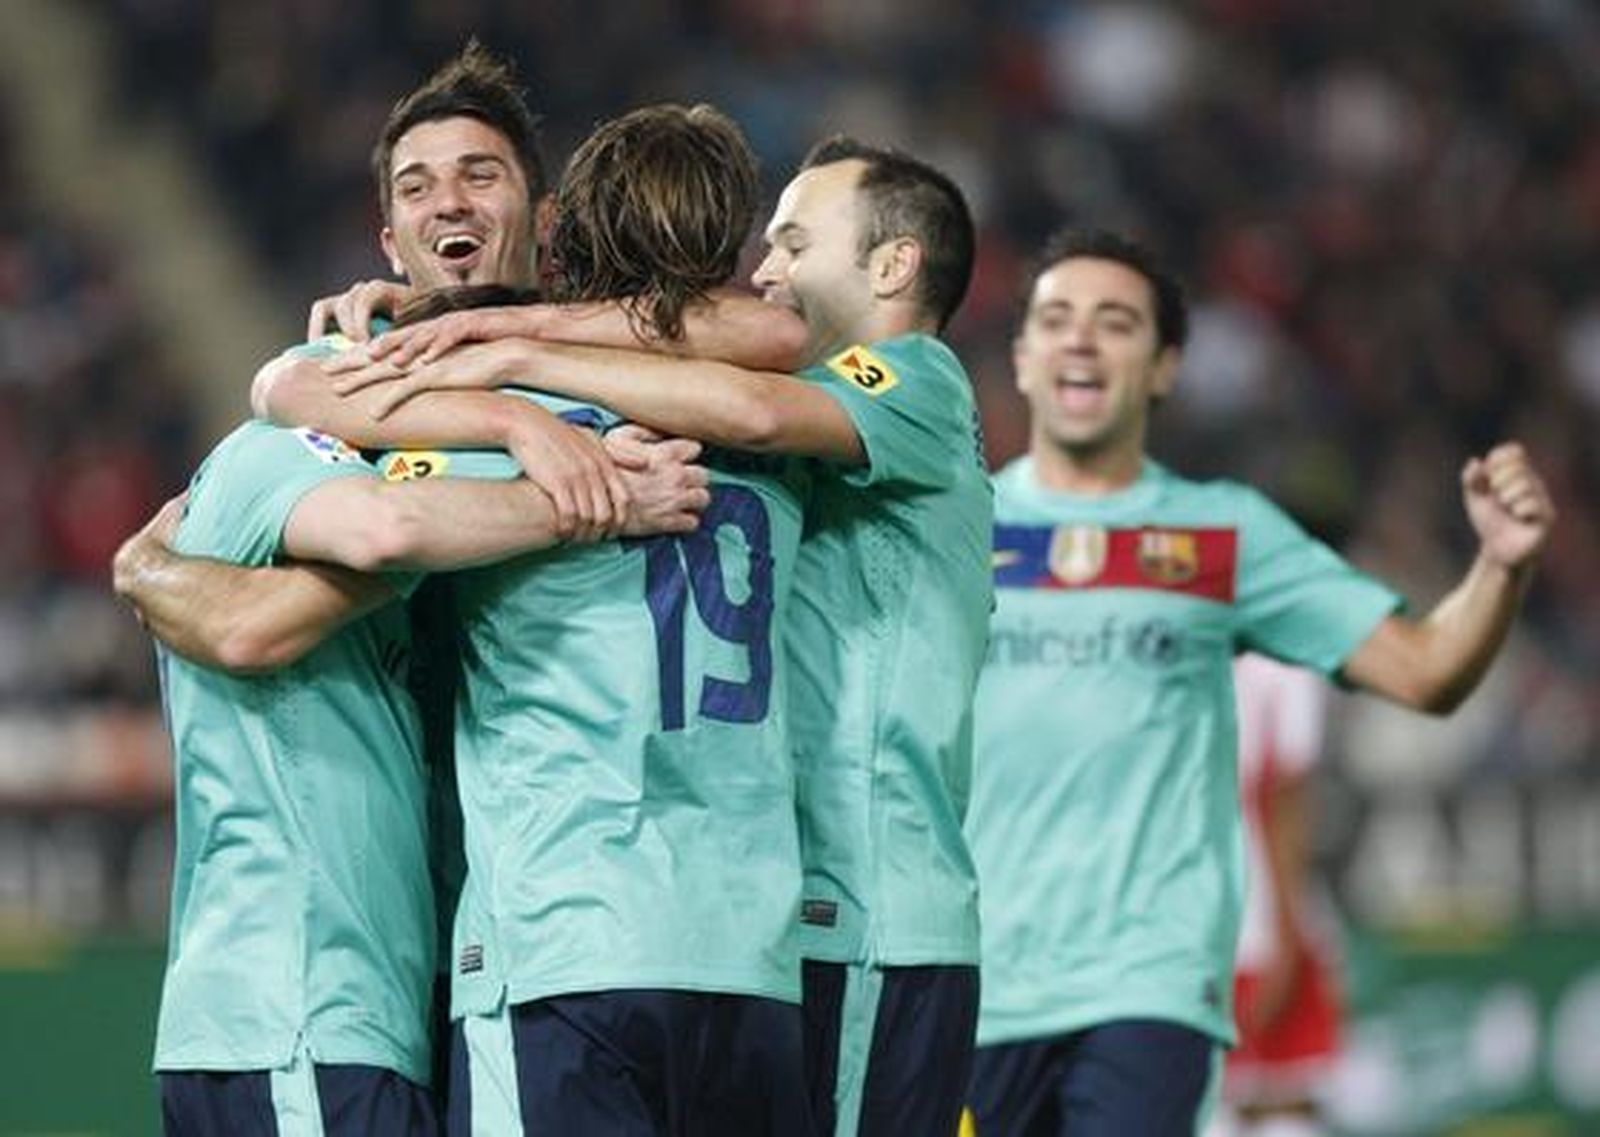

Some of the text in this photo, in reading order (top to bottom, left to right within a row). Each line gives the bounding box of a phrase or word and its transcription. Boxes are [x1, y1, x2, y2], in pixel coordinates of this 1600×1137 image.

[854, 365, 884, 389] 3
[620, 482, 774, 731] 19
[985, 613, 1118, 668] nicef
